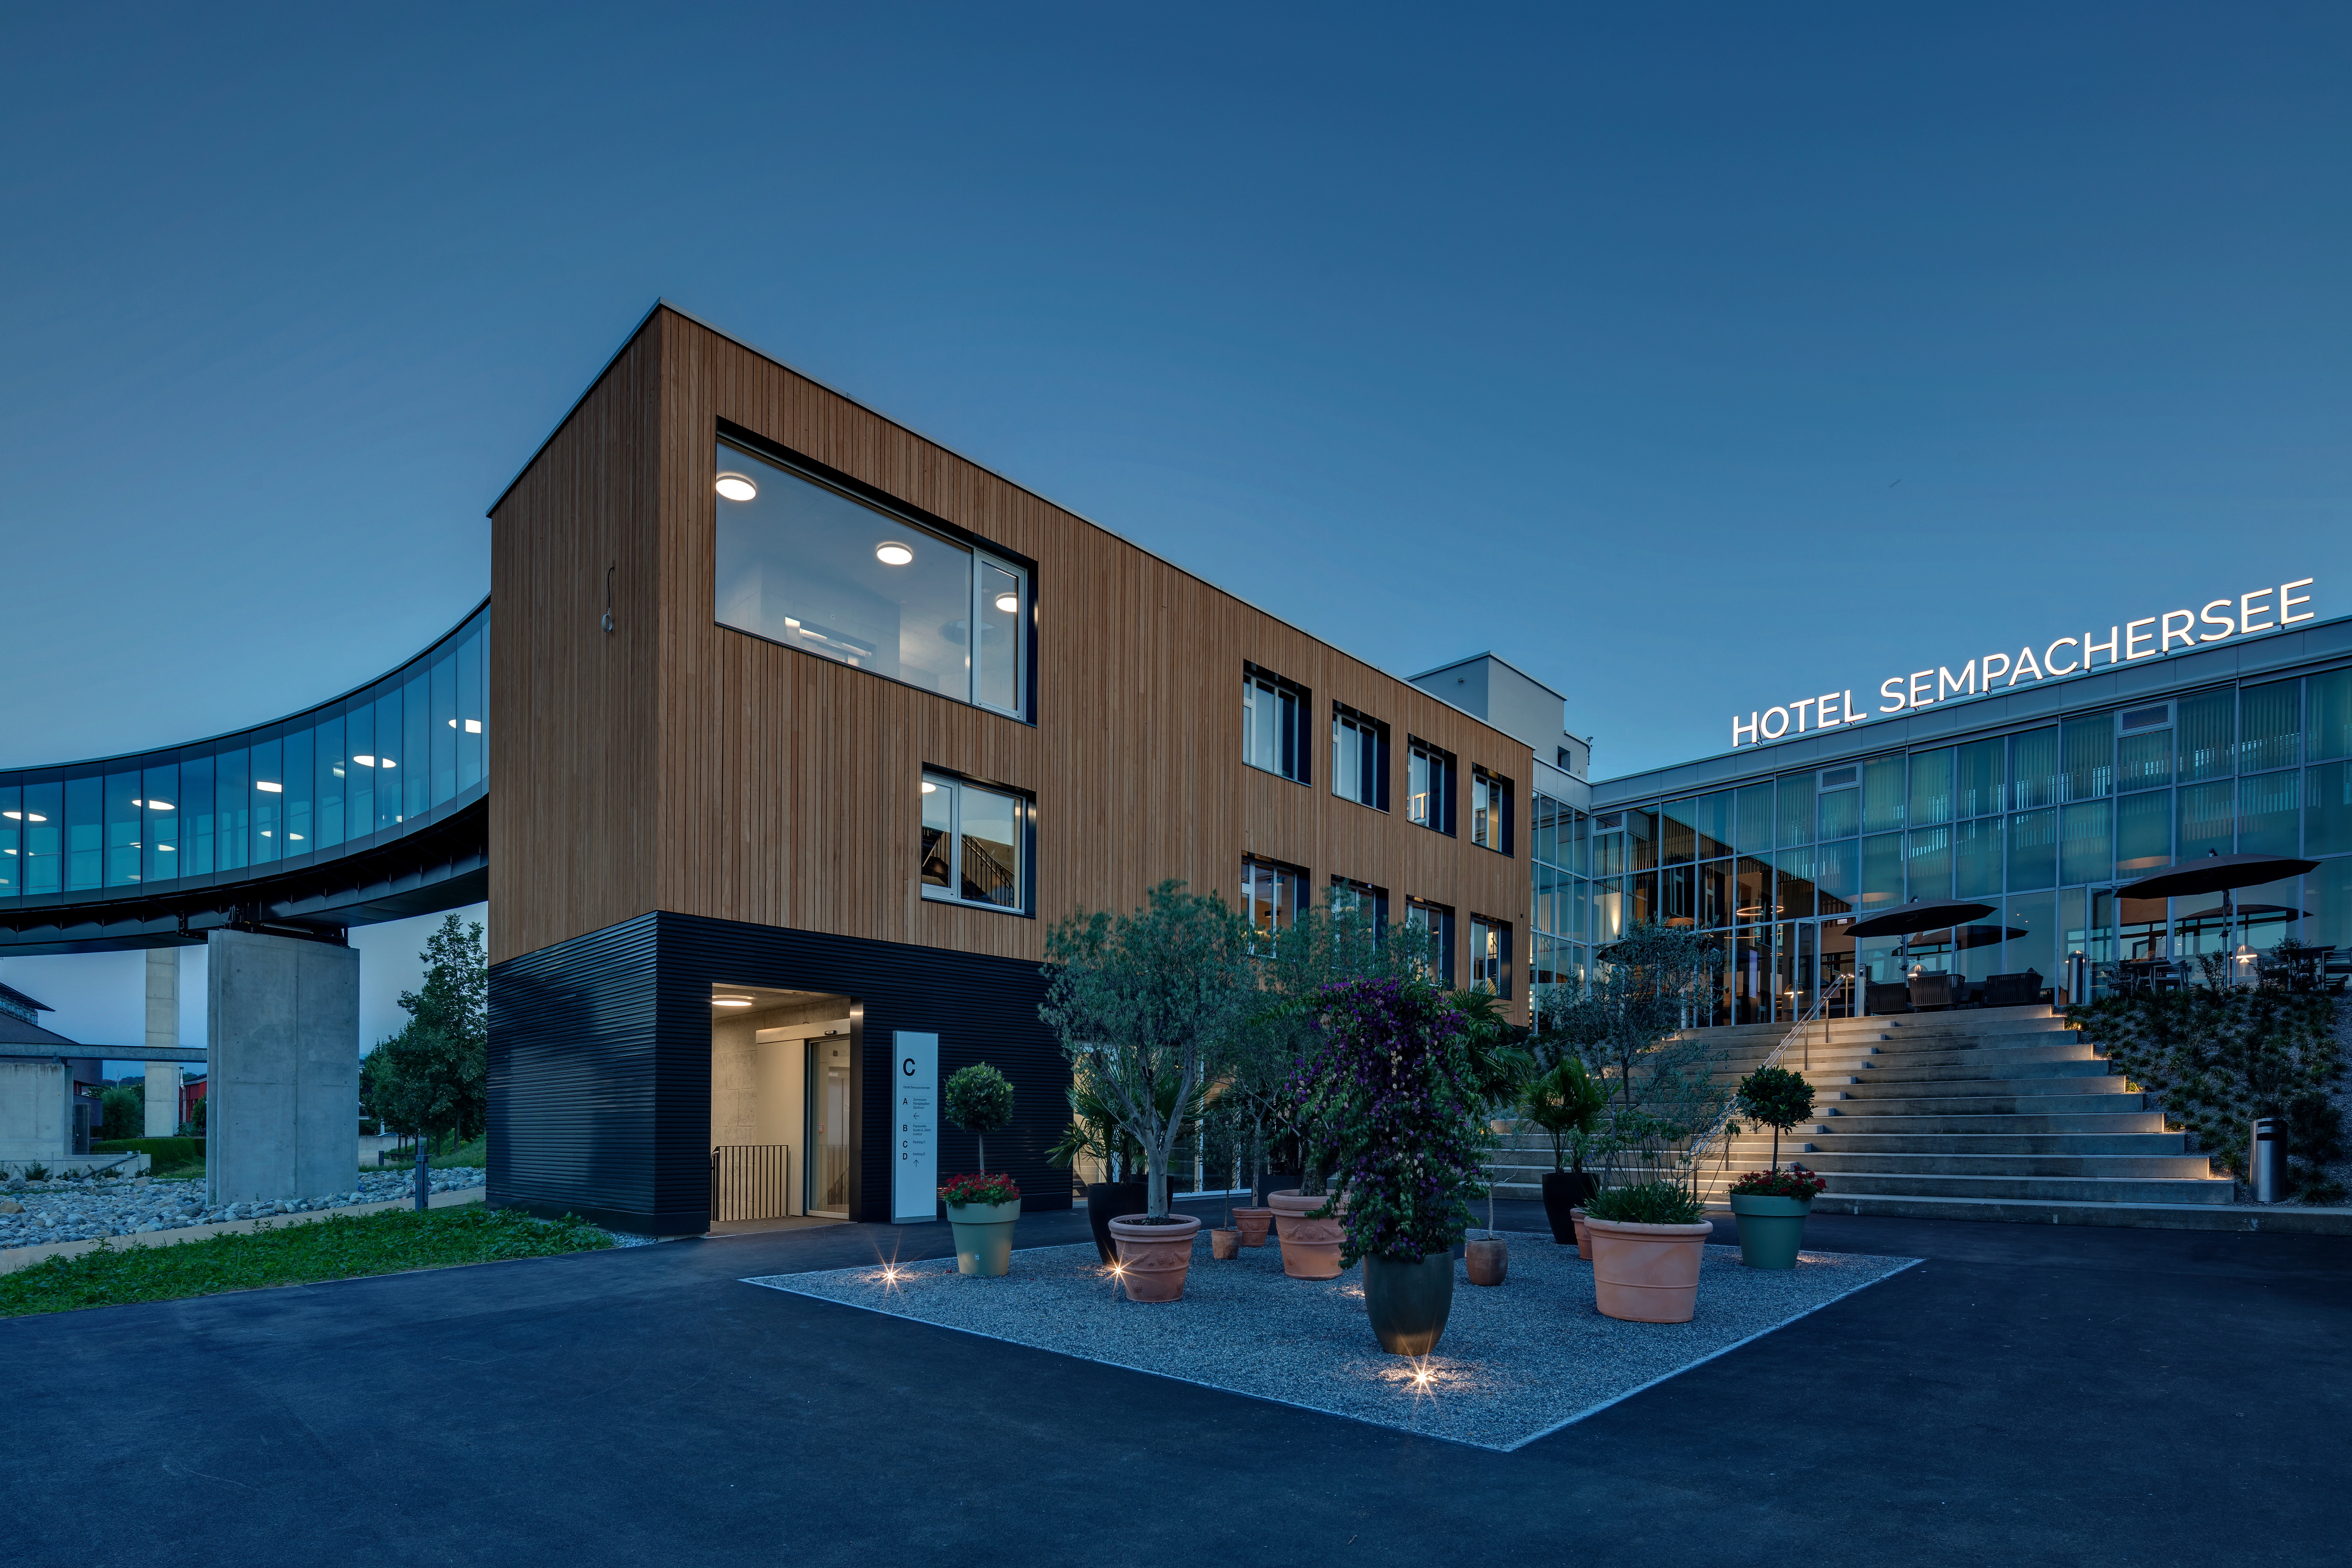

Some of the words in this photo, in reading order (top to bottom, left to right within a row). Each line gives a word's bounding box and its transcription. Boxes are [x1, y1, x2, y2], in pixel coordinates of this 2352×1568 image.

[1732, 688, 1867, 748] HOTEL
[1879, 577, 2315, 714] SEMPACHERSEE
[903, 1058, 916, 1076] C
[903, 1097, 908, 1105] A
[903, 1140, 908, 1148] C
